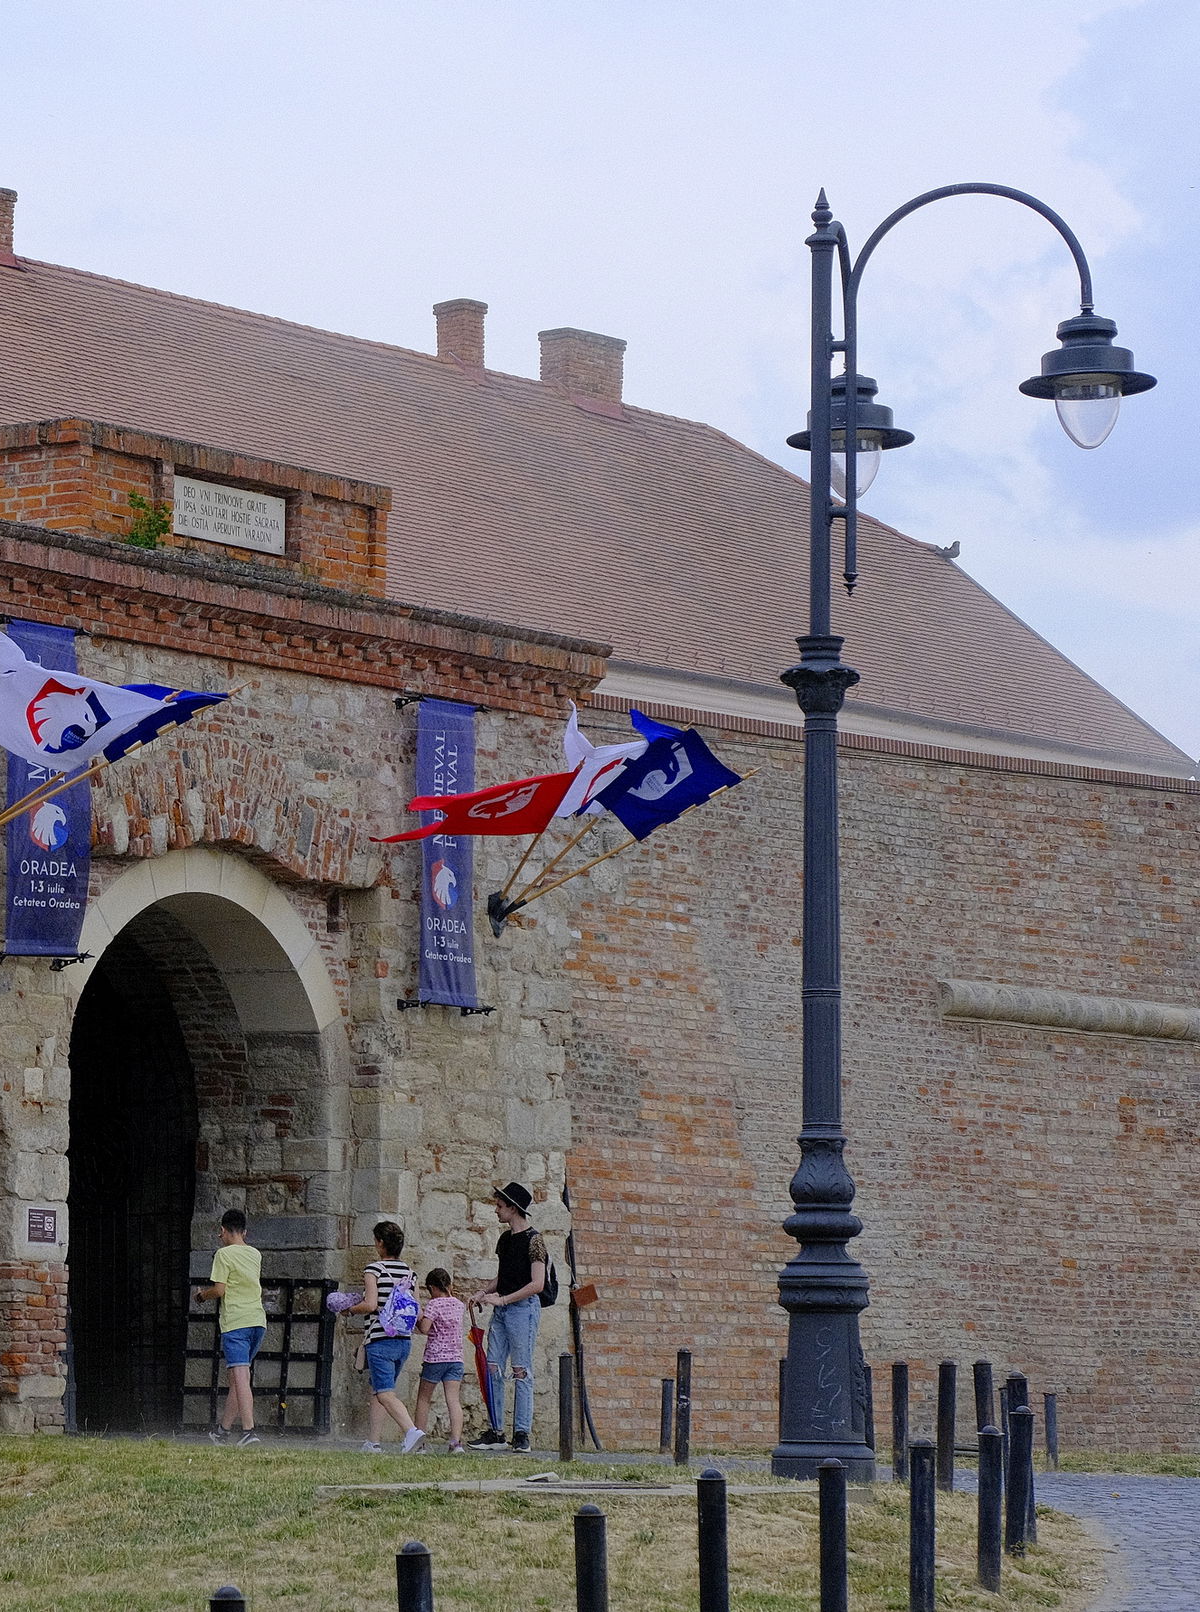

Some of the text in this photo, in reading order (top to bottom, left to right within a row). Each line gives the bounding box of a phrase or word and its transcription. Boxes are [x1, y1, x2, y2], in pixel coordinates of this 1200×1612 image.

[183, 486, 196, 498] DEO
[200, 489, 211, 502] VNI
[184, 501, 197, 513] IPSA
[200, 504, 228, 520] SALVTARI
[231, 510, 251, 525] HOSTIE
[191, 516, 208, 531] OSTIA
[20, 859, 77, 877] ORADEA
[30, 880, 65, 894] 1-3 iulie
[13, 896, 80, 910] Cetatea Oradea
[426, 916, 467, 934] ORADEA
